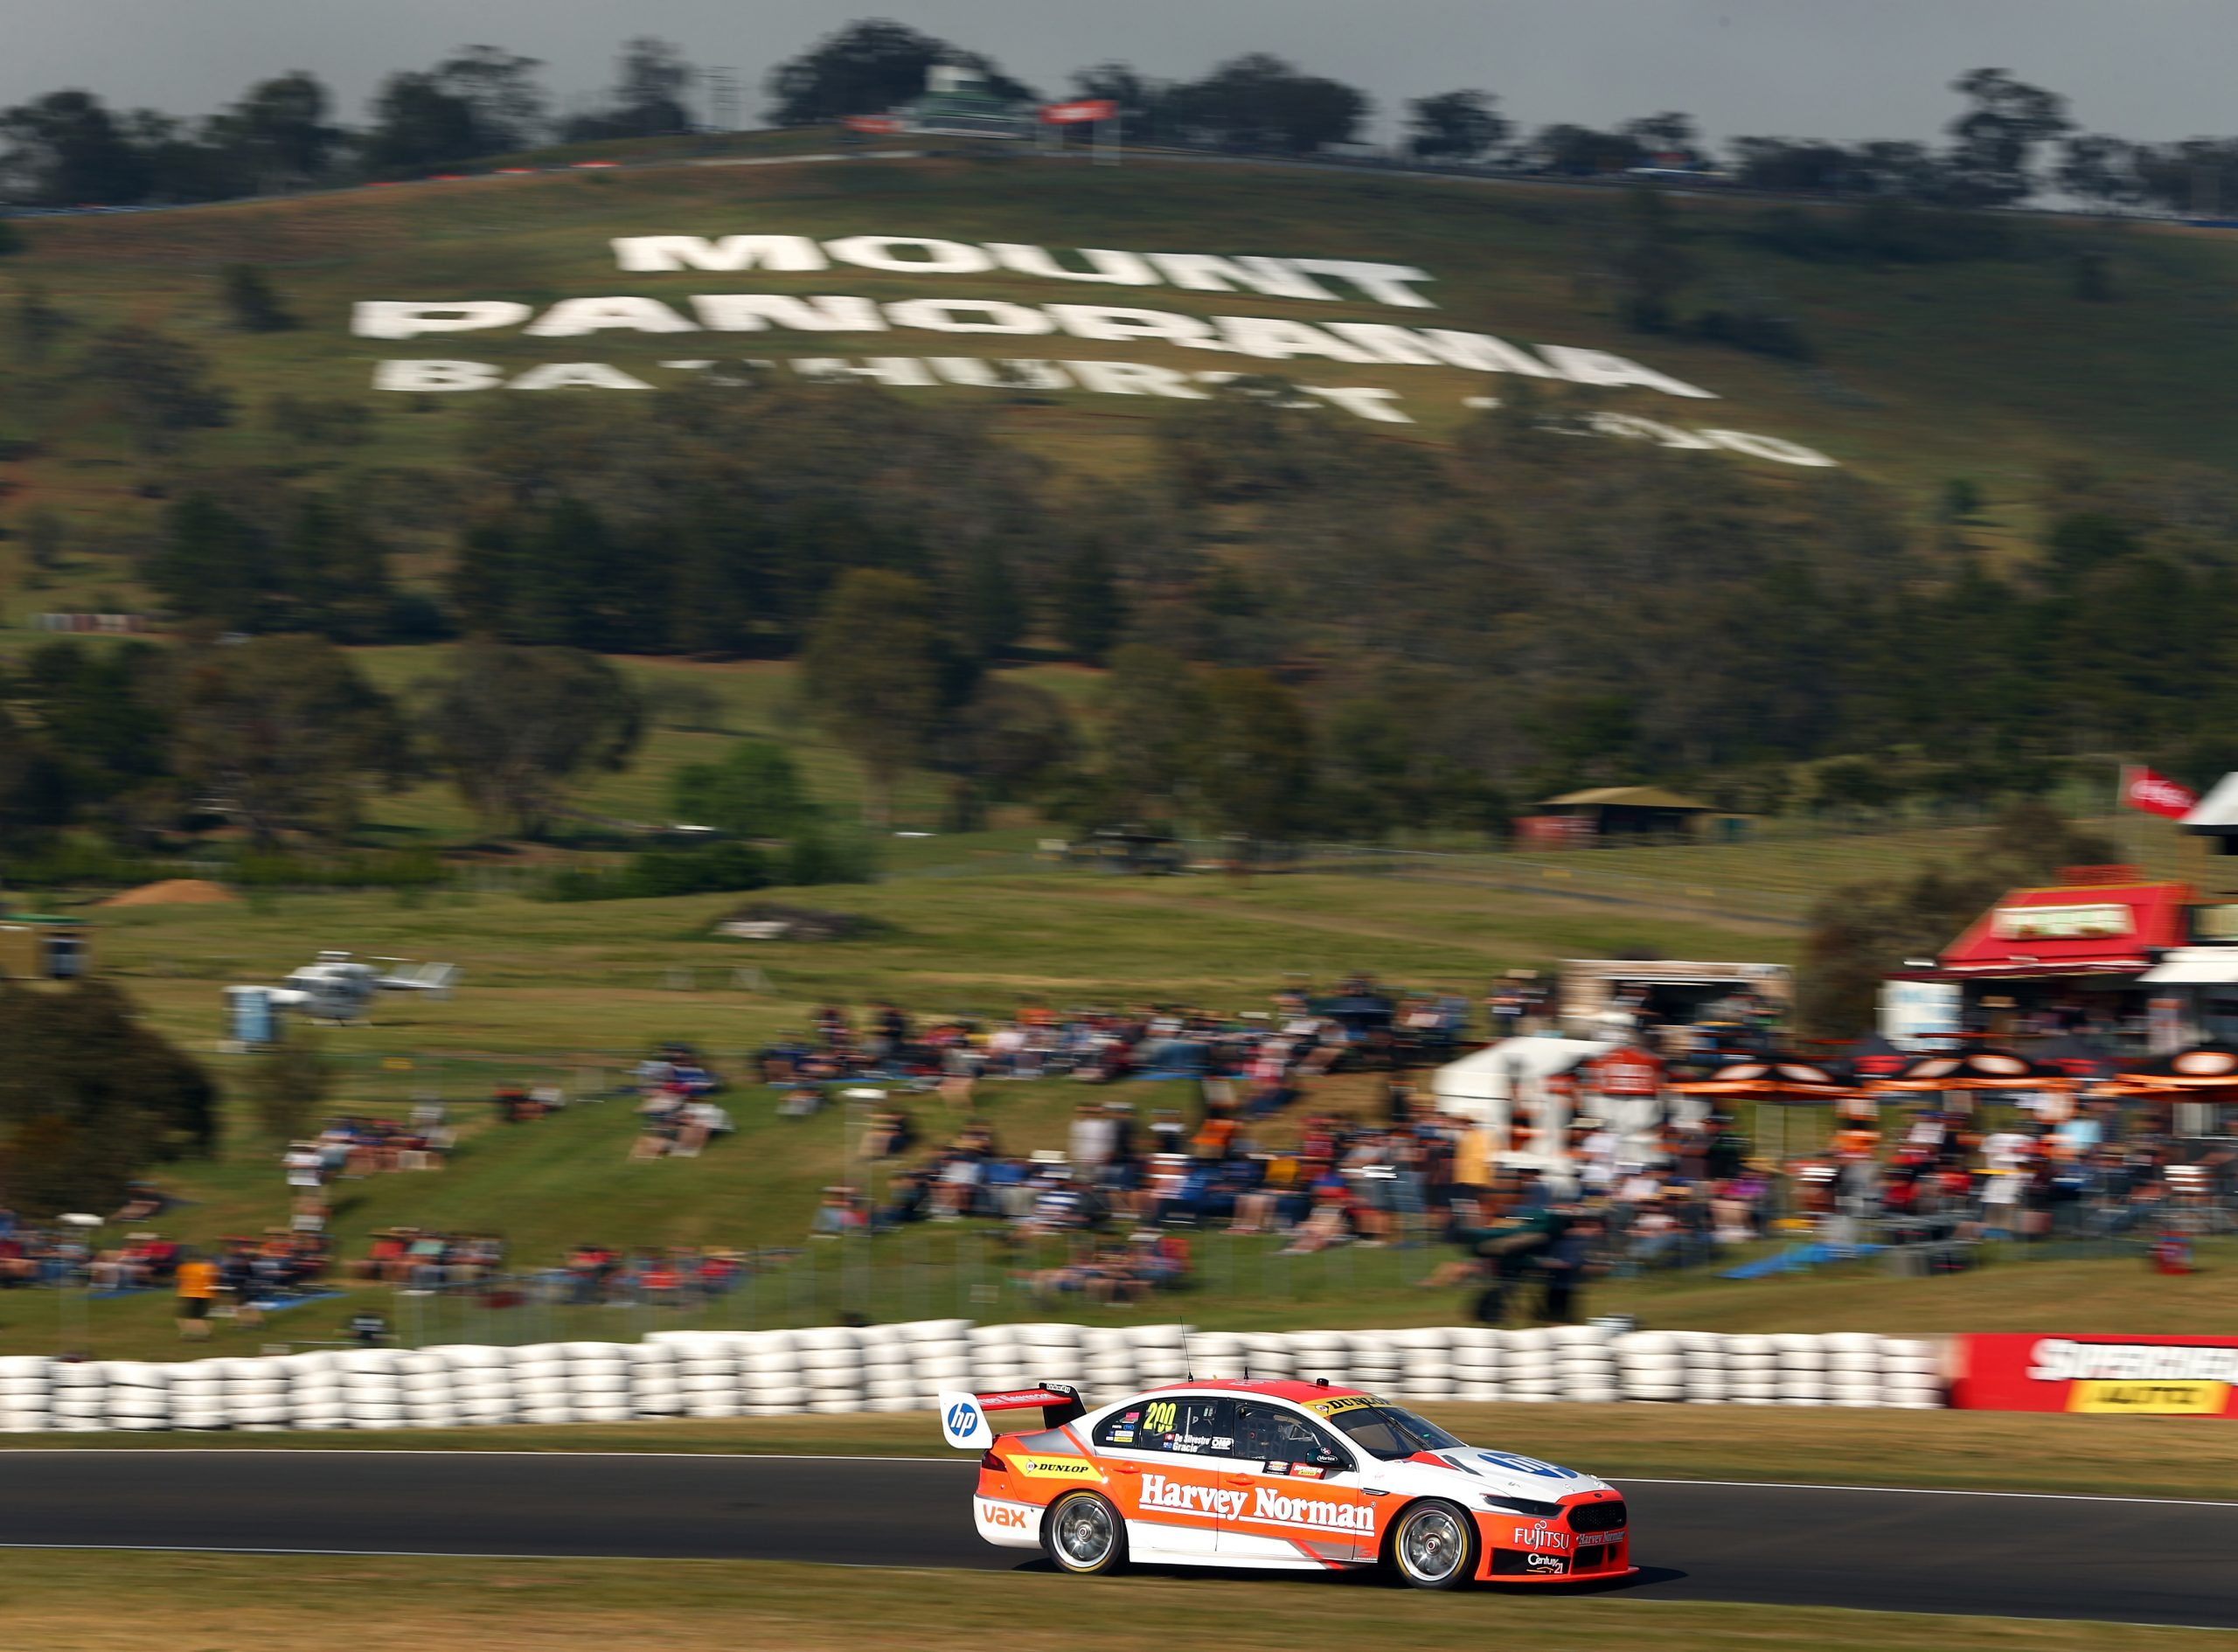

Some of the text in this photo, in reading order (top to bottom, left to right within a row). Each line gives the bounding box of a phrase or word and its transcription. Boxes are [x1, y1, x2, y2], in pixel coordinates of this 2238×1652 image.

[611, 234, 1439, 309] MOUNT
[352, 295, 1720, 398] PANORAMA
[949, 1402, 977, 1438] hp
[1143, 1402, 1177, 1433] 200
[1172, 1442, 1199, 1453] Gracie
[1174, 1433, 1212, 1446] De Silvestre
[1211, 1439, 1232, 1447] OMP
[1038, 1463, 1089, 1473] DUNLOP
[1137, 1473, 1375, 1531] Harvey Norman
[983, 1503, 1026, 1529] vax
[1513, 1526, 1571, 1551] FUJITSU
[1578, 1532, 1603, 1545] Harvey
[1527, 1552, 1564, 1574] Century 21
